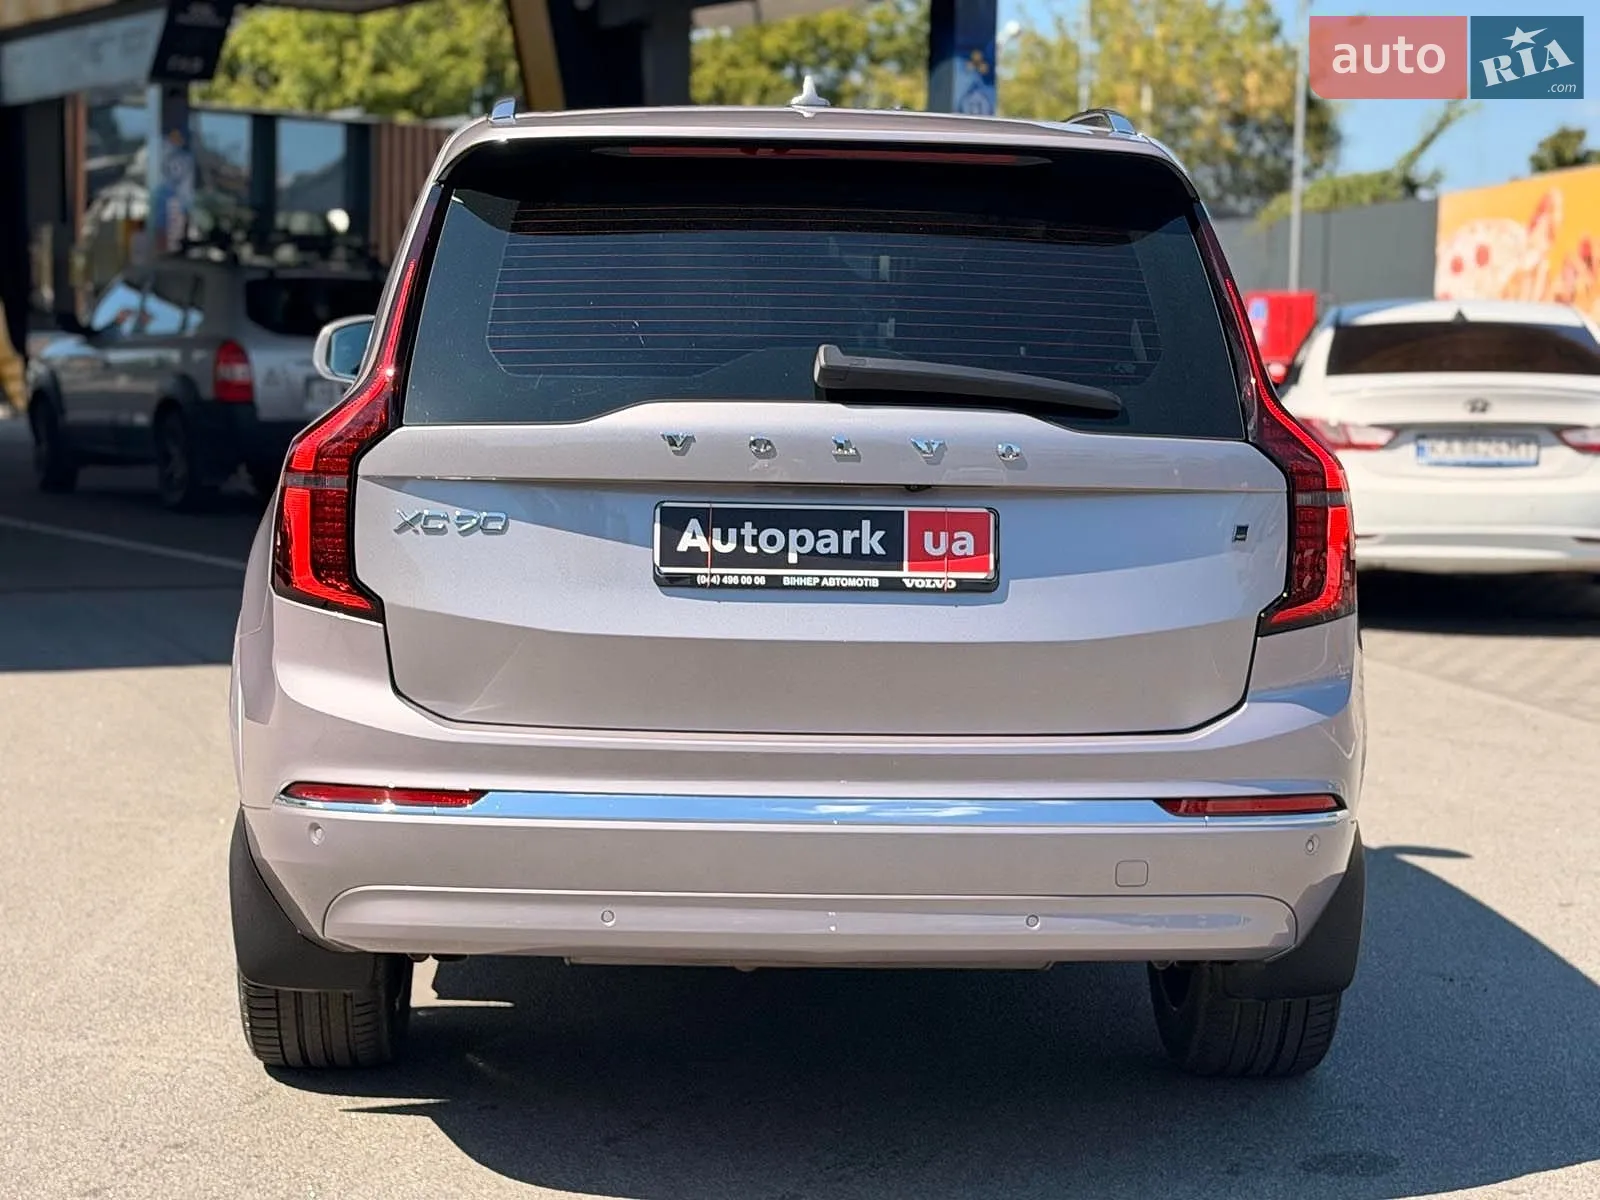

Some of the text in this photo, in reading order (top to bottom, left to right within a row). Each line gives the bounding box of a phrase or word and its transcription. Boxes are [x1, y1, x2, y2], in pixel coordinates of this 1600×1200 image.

[660, 431, 1022, 462] VOLVO
[395, 509, 507, 534] XC90
[676, 518, 975, 564] Autopark ua
[740, 575, 753, 586] 00
[902, 578, 957, 590] VOLVO
